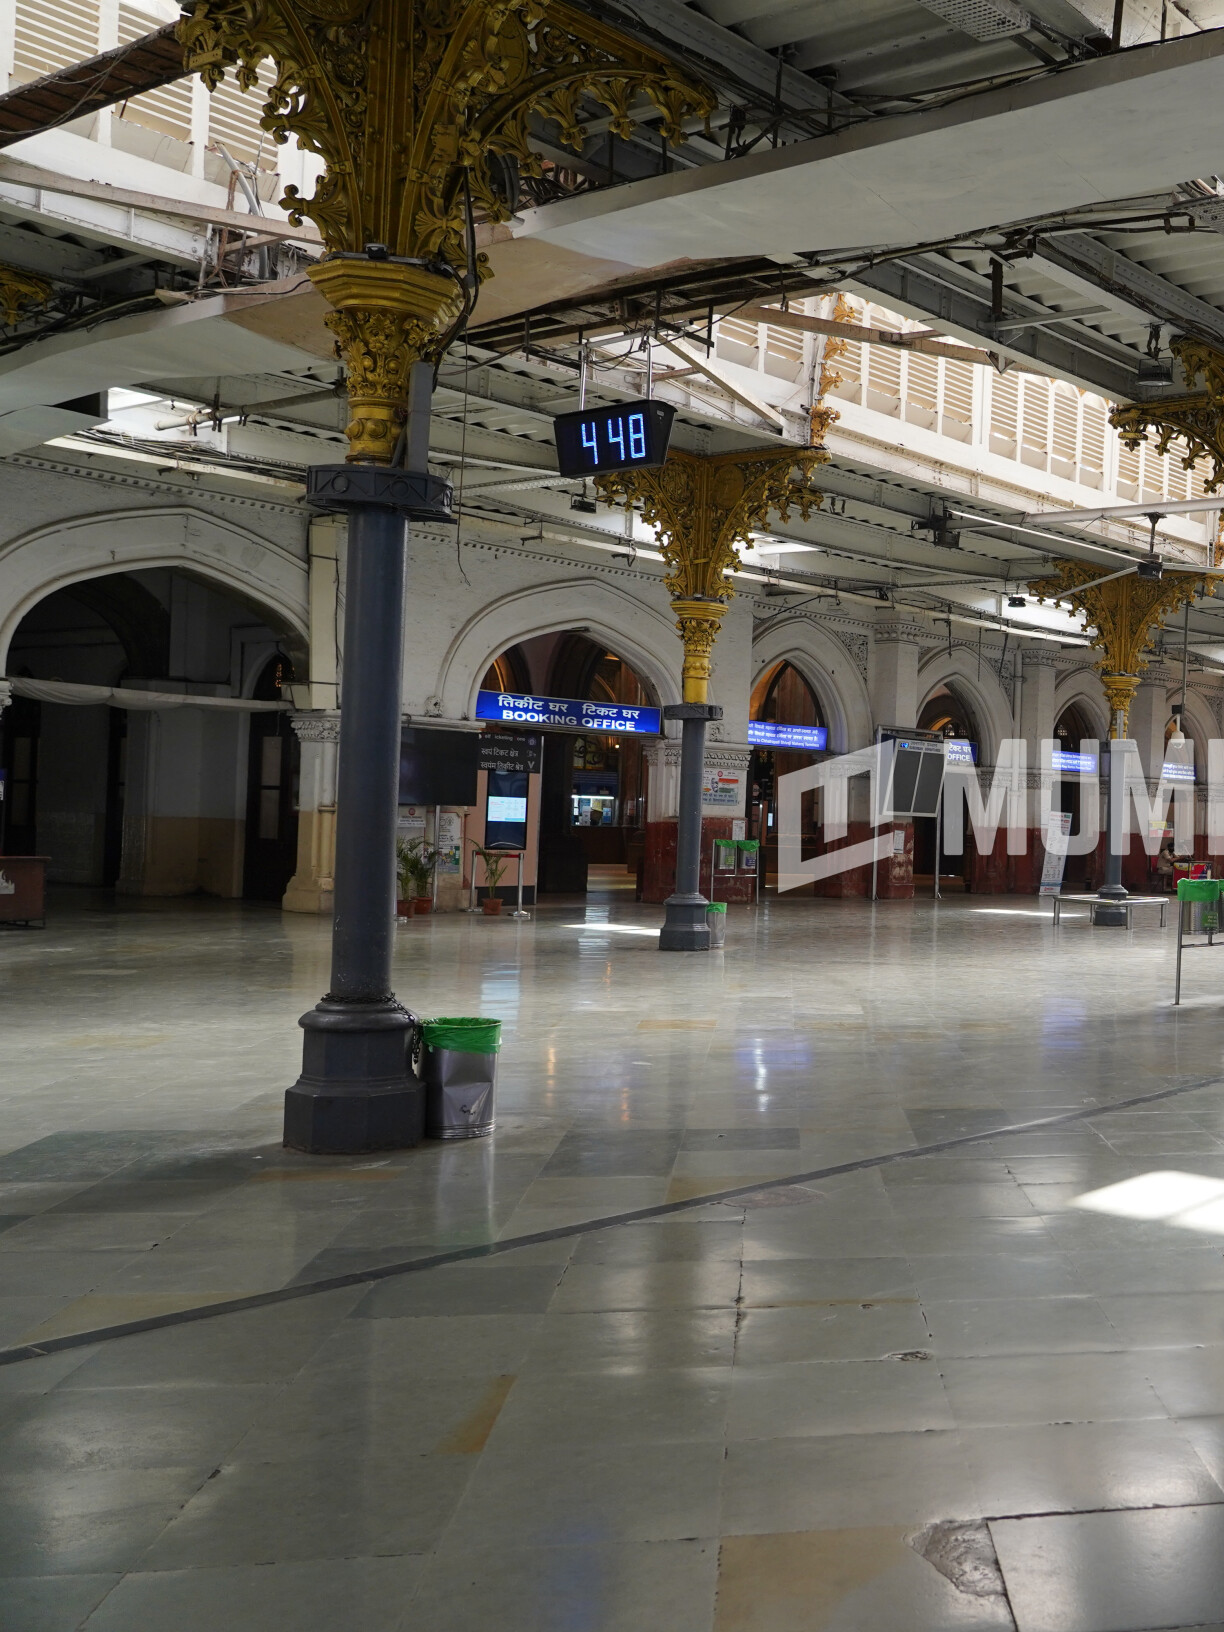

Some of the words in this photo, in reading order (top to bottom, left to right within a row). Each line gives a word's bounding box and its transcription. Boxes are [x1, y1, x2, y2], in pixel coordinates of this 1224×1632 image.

[498, 694, 544, 711] तिकीट
[549, 702, 568, 713] घर
[582, 702, 618, 718] टिकट
[622, 709, 640, 720] घर
[502, 709, 577, 726] BOOKING
[581, 717, 636, 731] OFFICE
[947, 753, 971, 762] OFFICE
